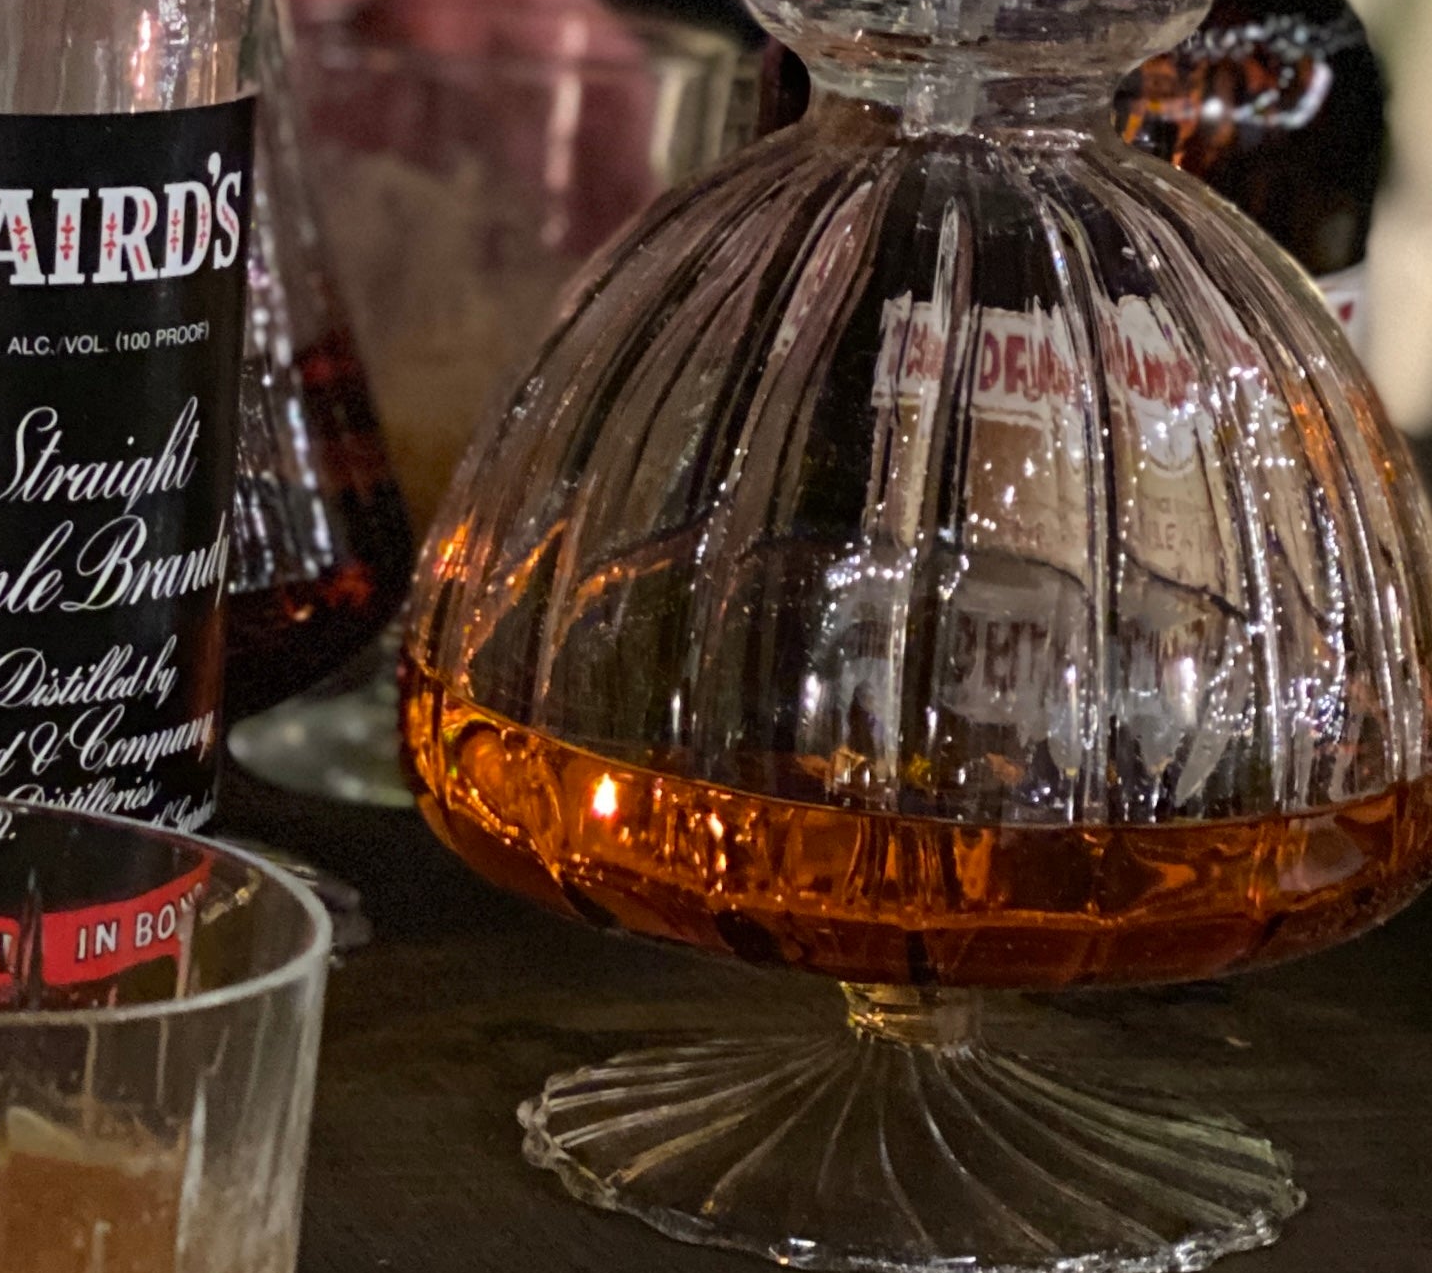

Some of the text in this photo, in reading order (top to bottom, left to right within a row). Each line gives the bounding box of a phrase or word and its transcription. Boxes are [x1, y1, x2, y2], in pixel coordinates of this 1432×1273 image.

[116, 331, 151, 352] (100
[156, 321, 210, 347] PROOF)
[140, 634, 178, 709] by
[68, 704, 215, 772] Company
[76, 921, 118, 960] IN
